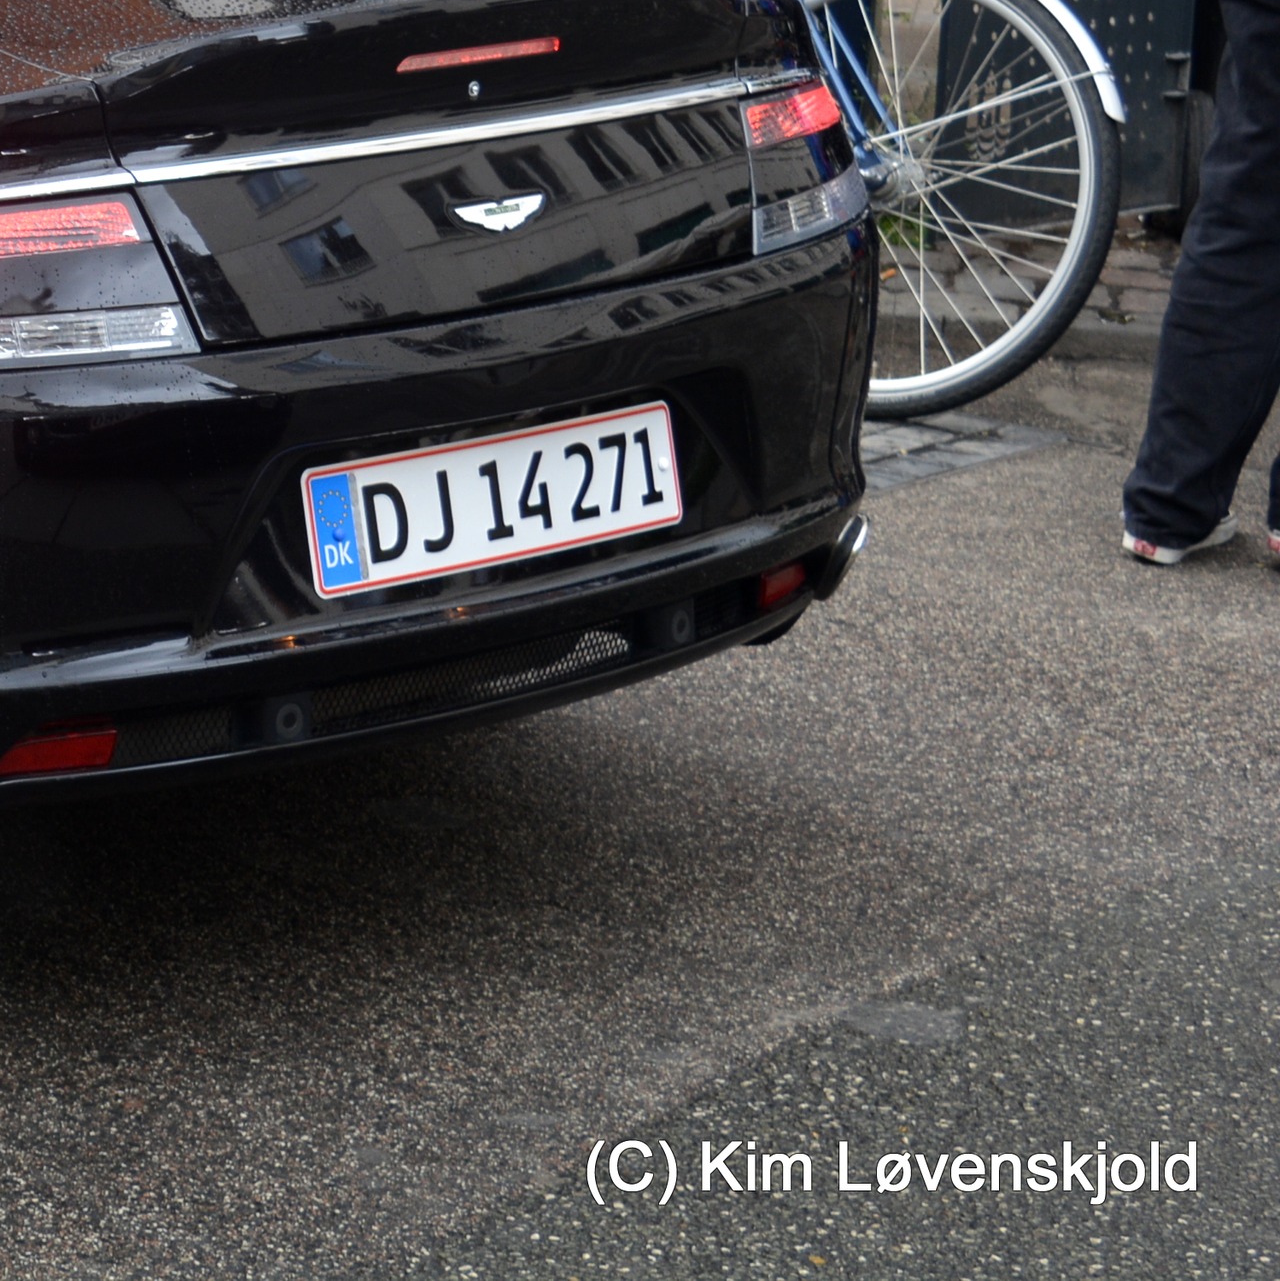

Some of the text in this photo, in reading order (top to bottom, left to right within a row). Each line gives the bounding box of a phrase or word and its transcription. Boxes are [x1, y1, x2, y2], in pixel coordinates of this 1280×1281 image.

[360, 426, 665, 566] DJ 14 271
[323, 541, 354, 569] DK
